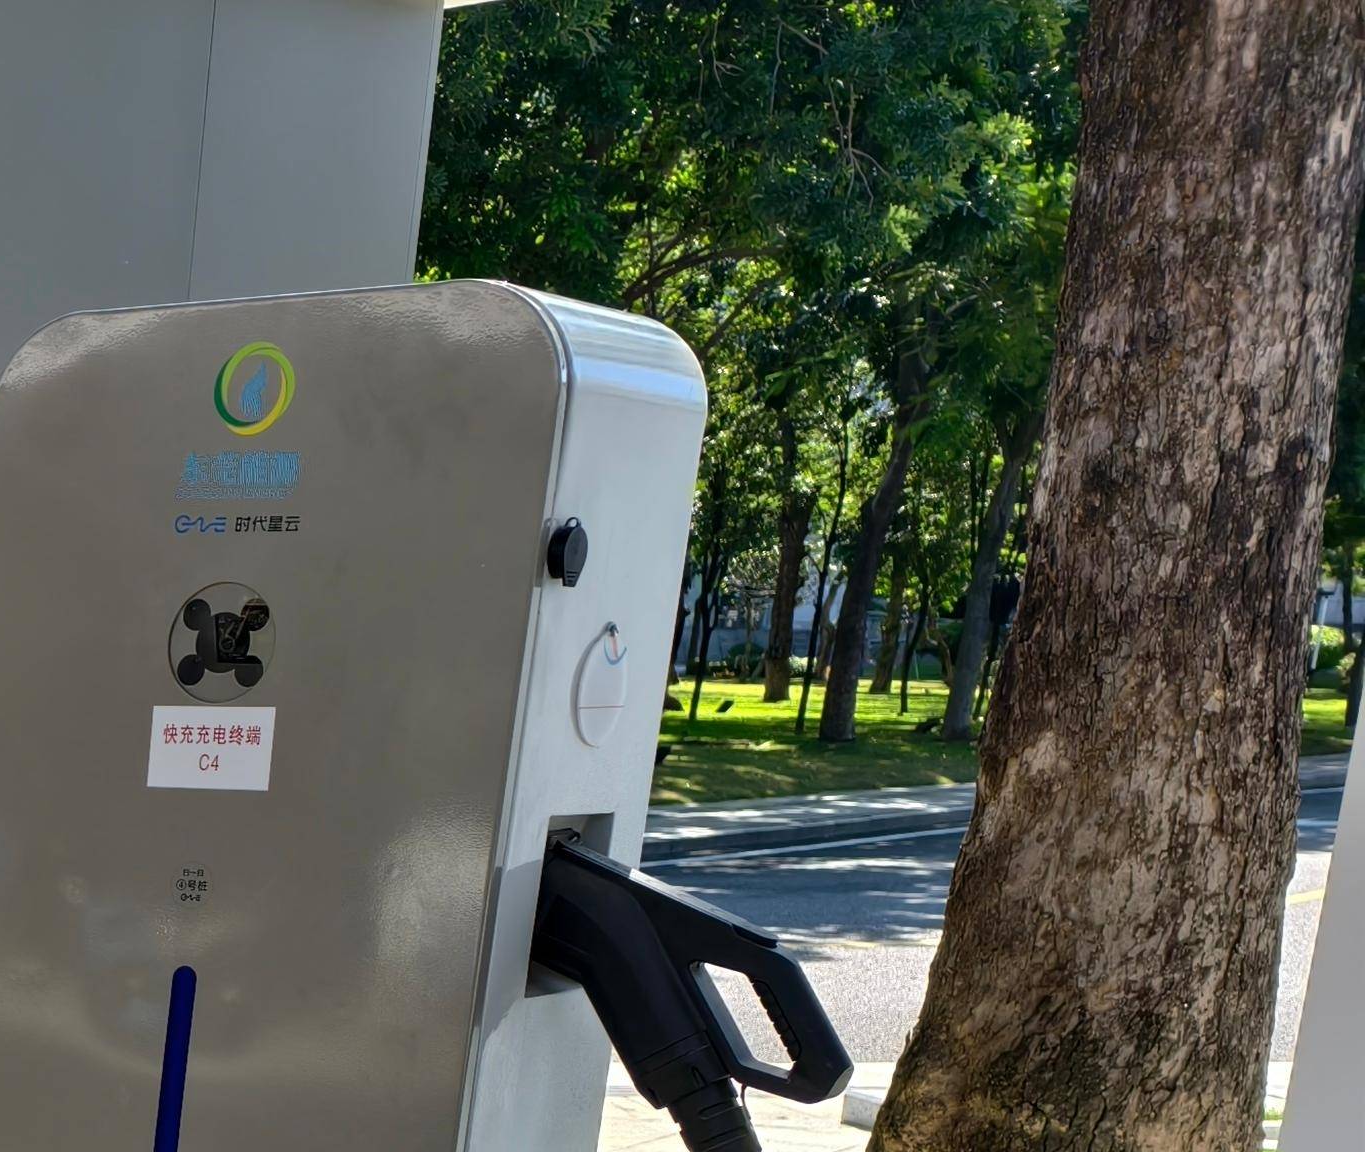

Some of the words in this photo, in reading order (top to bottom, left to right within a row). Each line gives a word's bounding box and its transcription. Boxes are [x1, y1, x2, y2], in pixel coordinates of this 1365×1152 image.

[234, 515, 301, 533] 时代星云
[163, 723, 262, 746] 快充充电终端
[198, 753, 220, 772] C4
